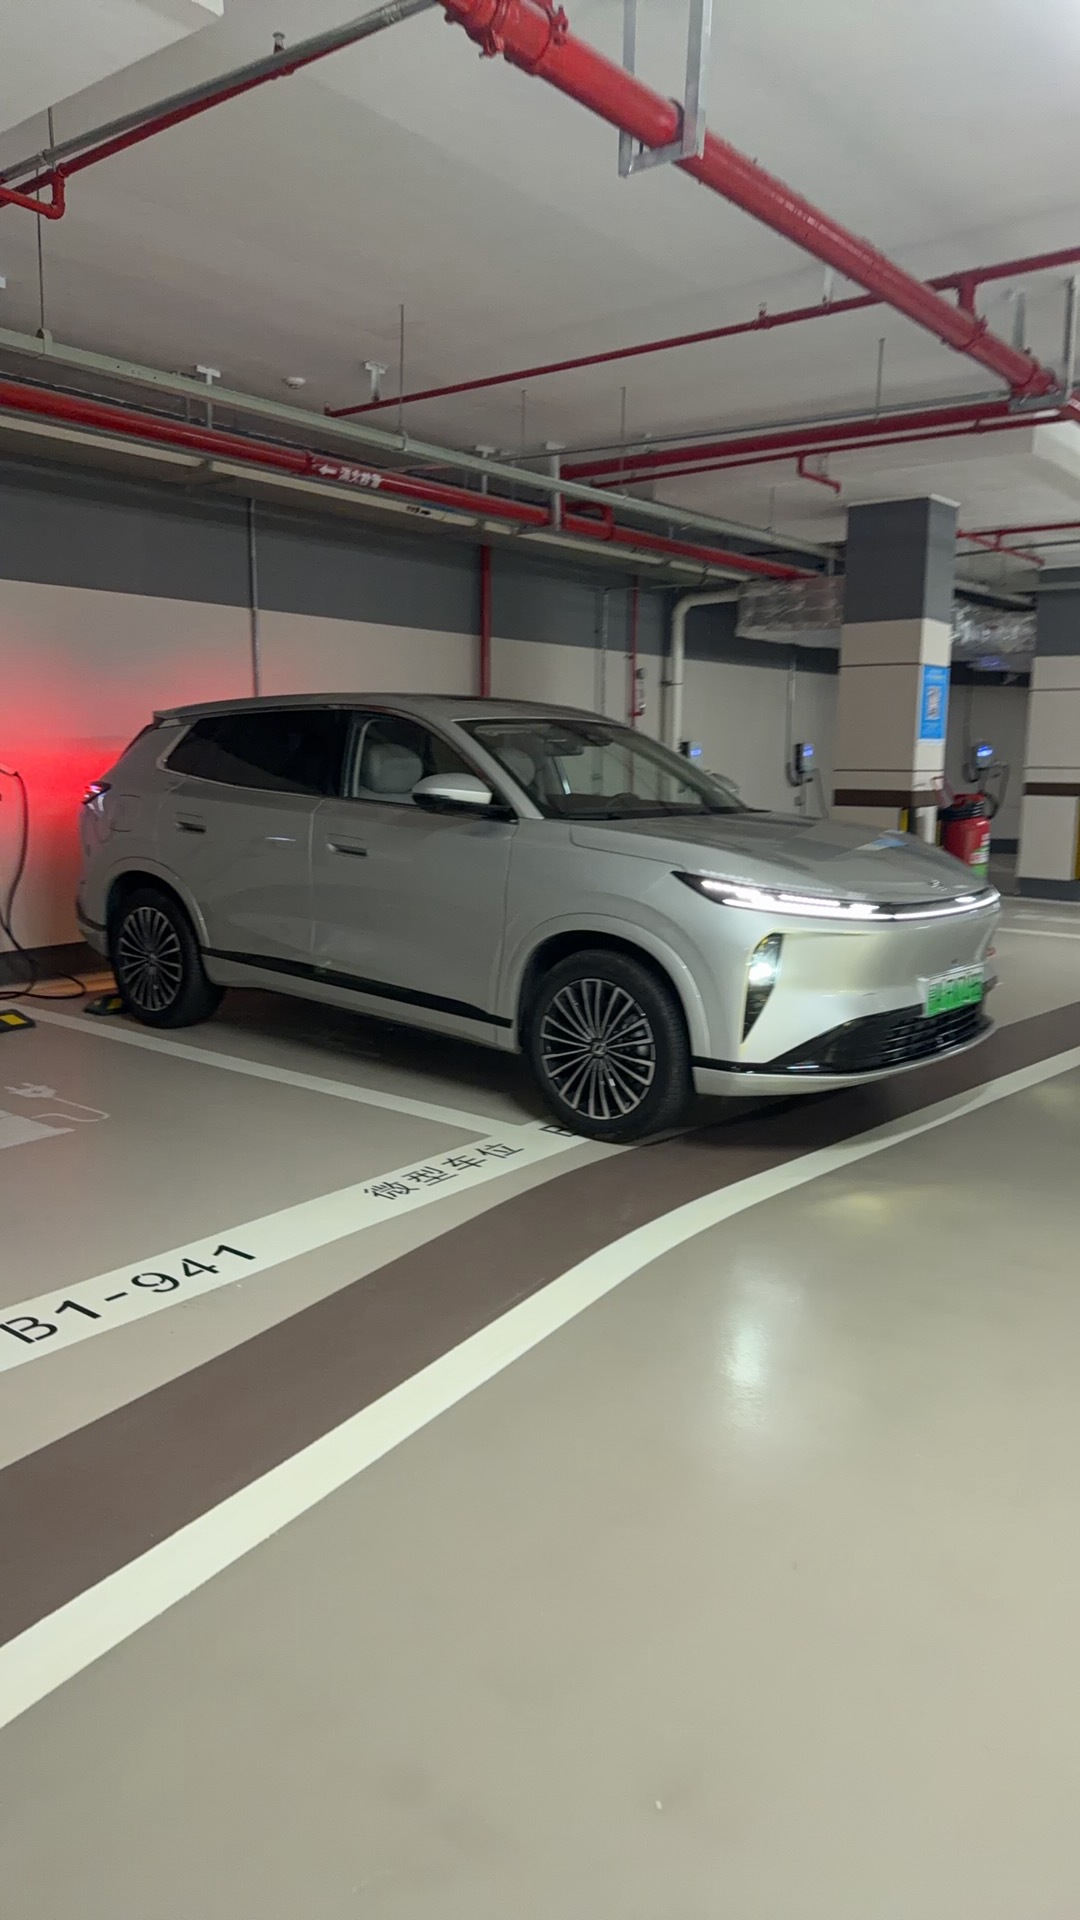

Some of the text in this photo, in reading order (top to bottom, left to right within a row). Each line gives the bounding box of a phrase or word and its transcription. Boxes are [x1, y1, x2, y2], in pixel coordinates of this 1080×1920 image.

[363, 1142, 525, 1201] 微型车位
[0, 1244, 257, 1345] B1-941
